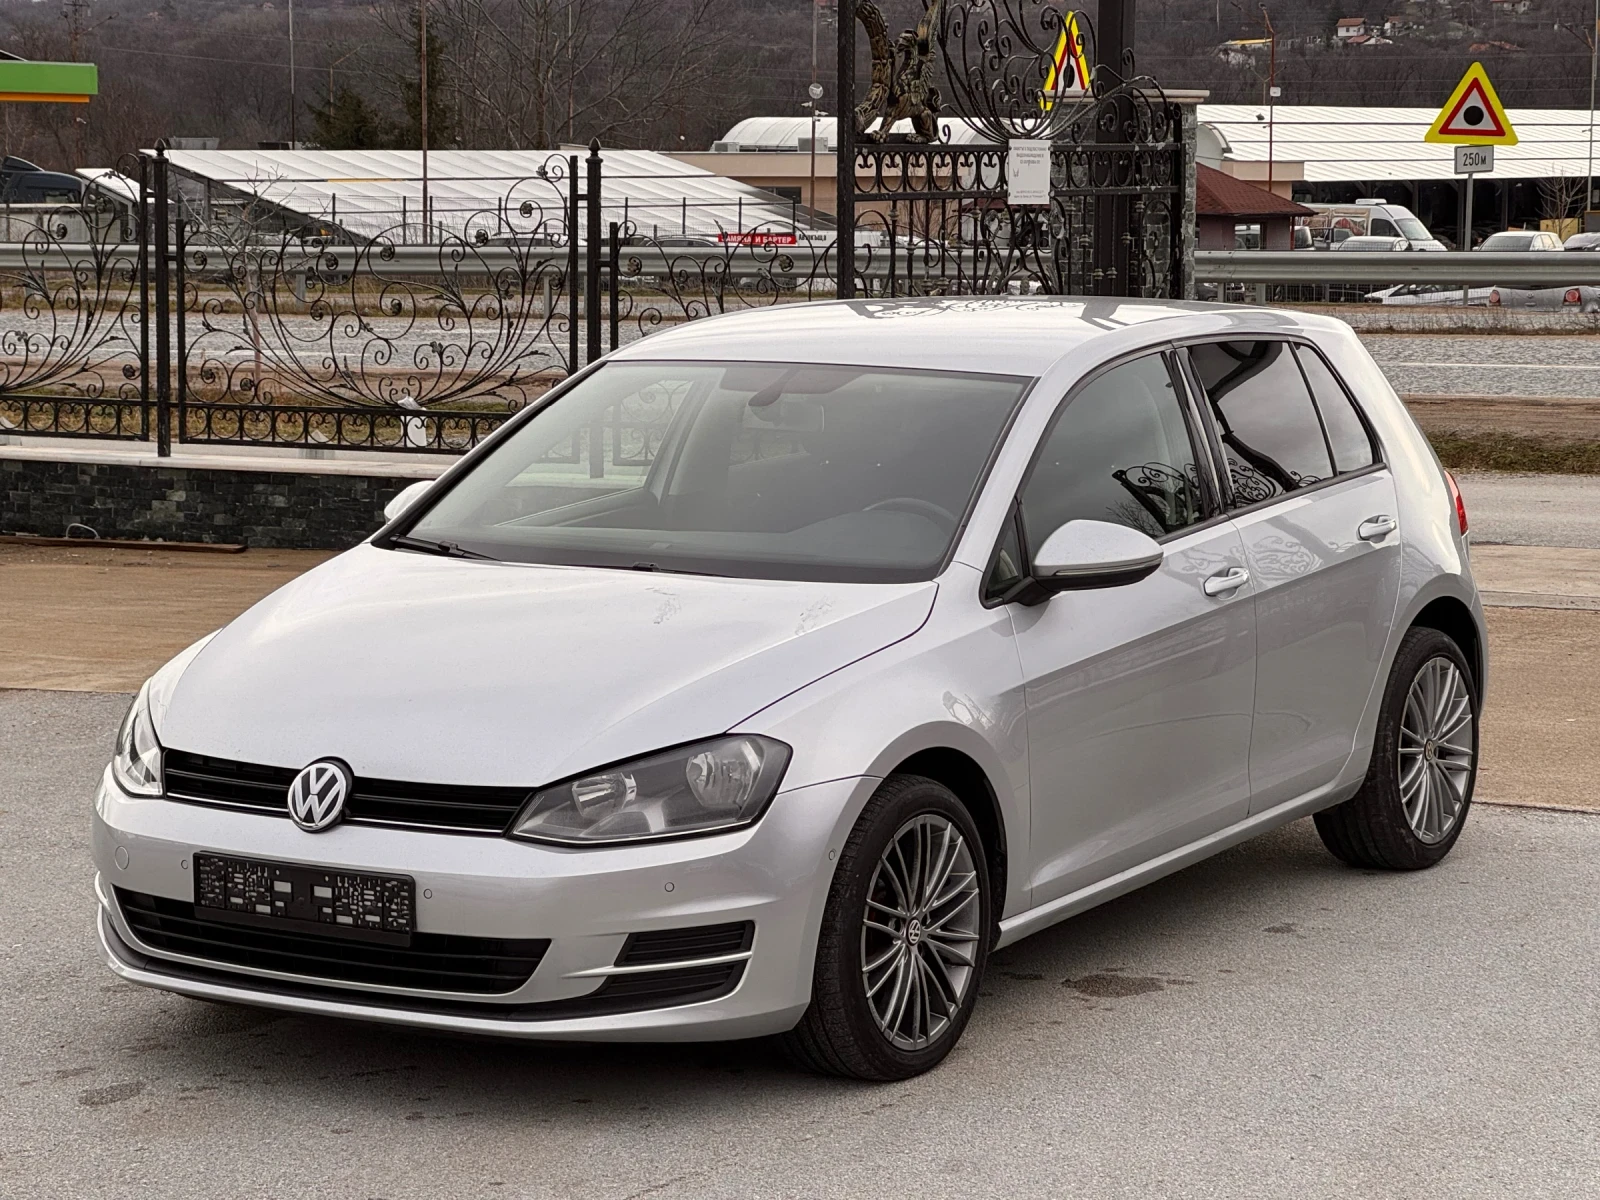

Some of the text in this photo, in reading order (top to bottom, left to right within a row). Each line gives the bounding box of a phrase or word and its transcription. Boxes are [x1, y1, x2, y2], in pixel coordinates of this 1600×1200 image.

[722, 234, 792, 244] АМЯНА И БАРТЕР
[289, 763, 346, 828] VW
